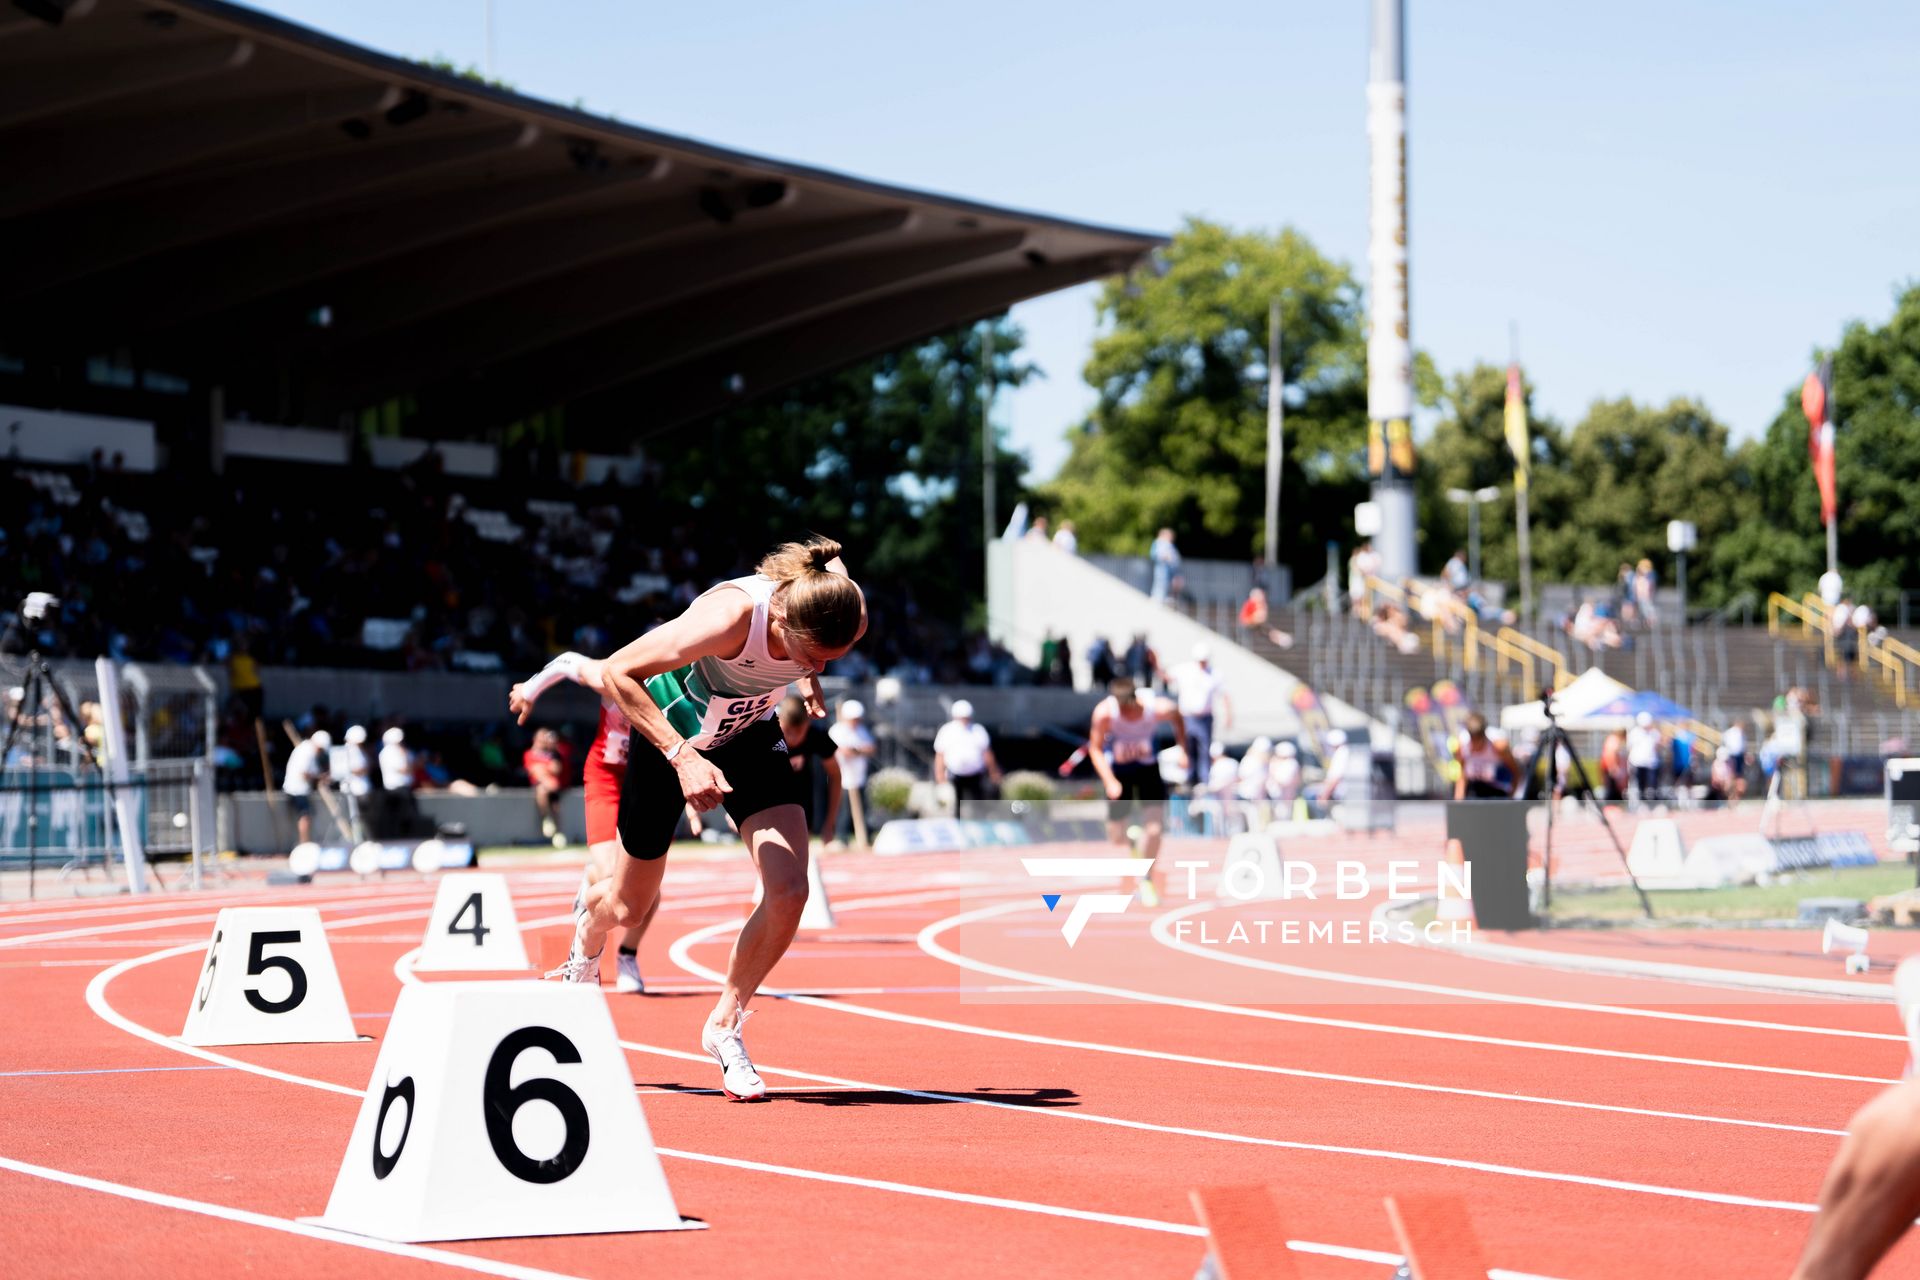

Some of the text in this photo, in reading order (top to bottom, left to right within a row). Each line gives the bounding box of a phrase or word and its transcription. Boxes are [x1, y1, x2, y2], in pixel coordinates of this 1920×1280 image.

[727, 695, 771, 715] GLS
[448, 892, 490, 946] 4
[244, 930, 308, 1014] 5
[484, 1025, 591, 1185] 6
